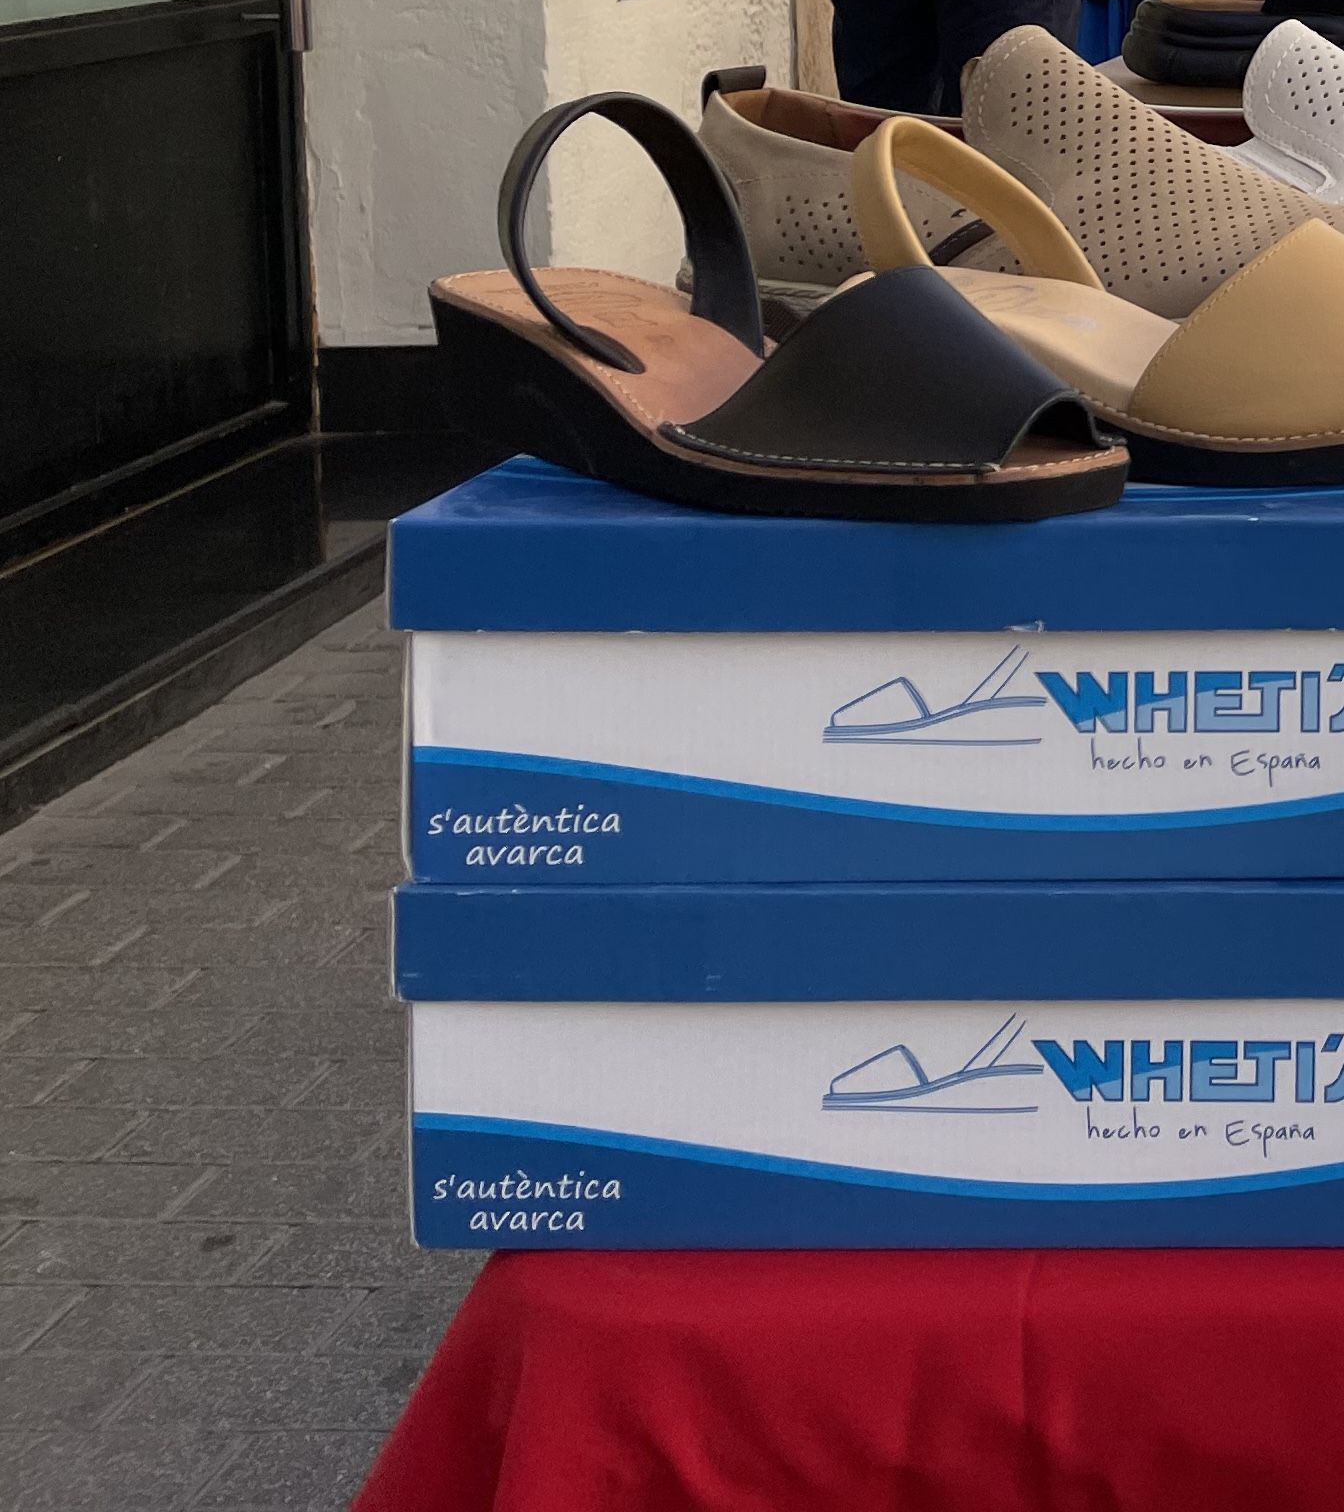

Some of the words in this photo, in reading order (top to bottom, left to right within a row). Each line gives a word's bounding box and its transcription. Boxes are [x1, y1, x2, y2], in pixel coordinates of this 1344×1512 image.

[1090, 737, 1165, 772] hecho
[1183, 754, 1213, 768] en
[1230, 749, 1321, 787] España
[427, 803, 621, 835] s'autèntica
[465, 844, 585, 866] avarca
[1086, 1106, 1161, 1140] hecho
[1178, 1124, 1208, 1138] en
[1225, 1120, 1316, 1158] España
[432, 1169, 621, 1200] s'autèntica
[469, 1210, 585, 1231] avarca
